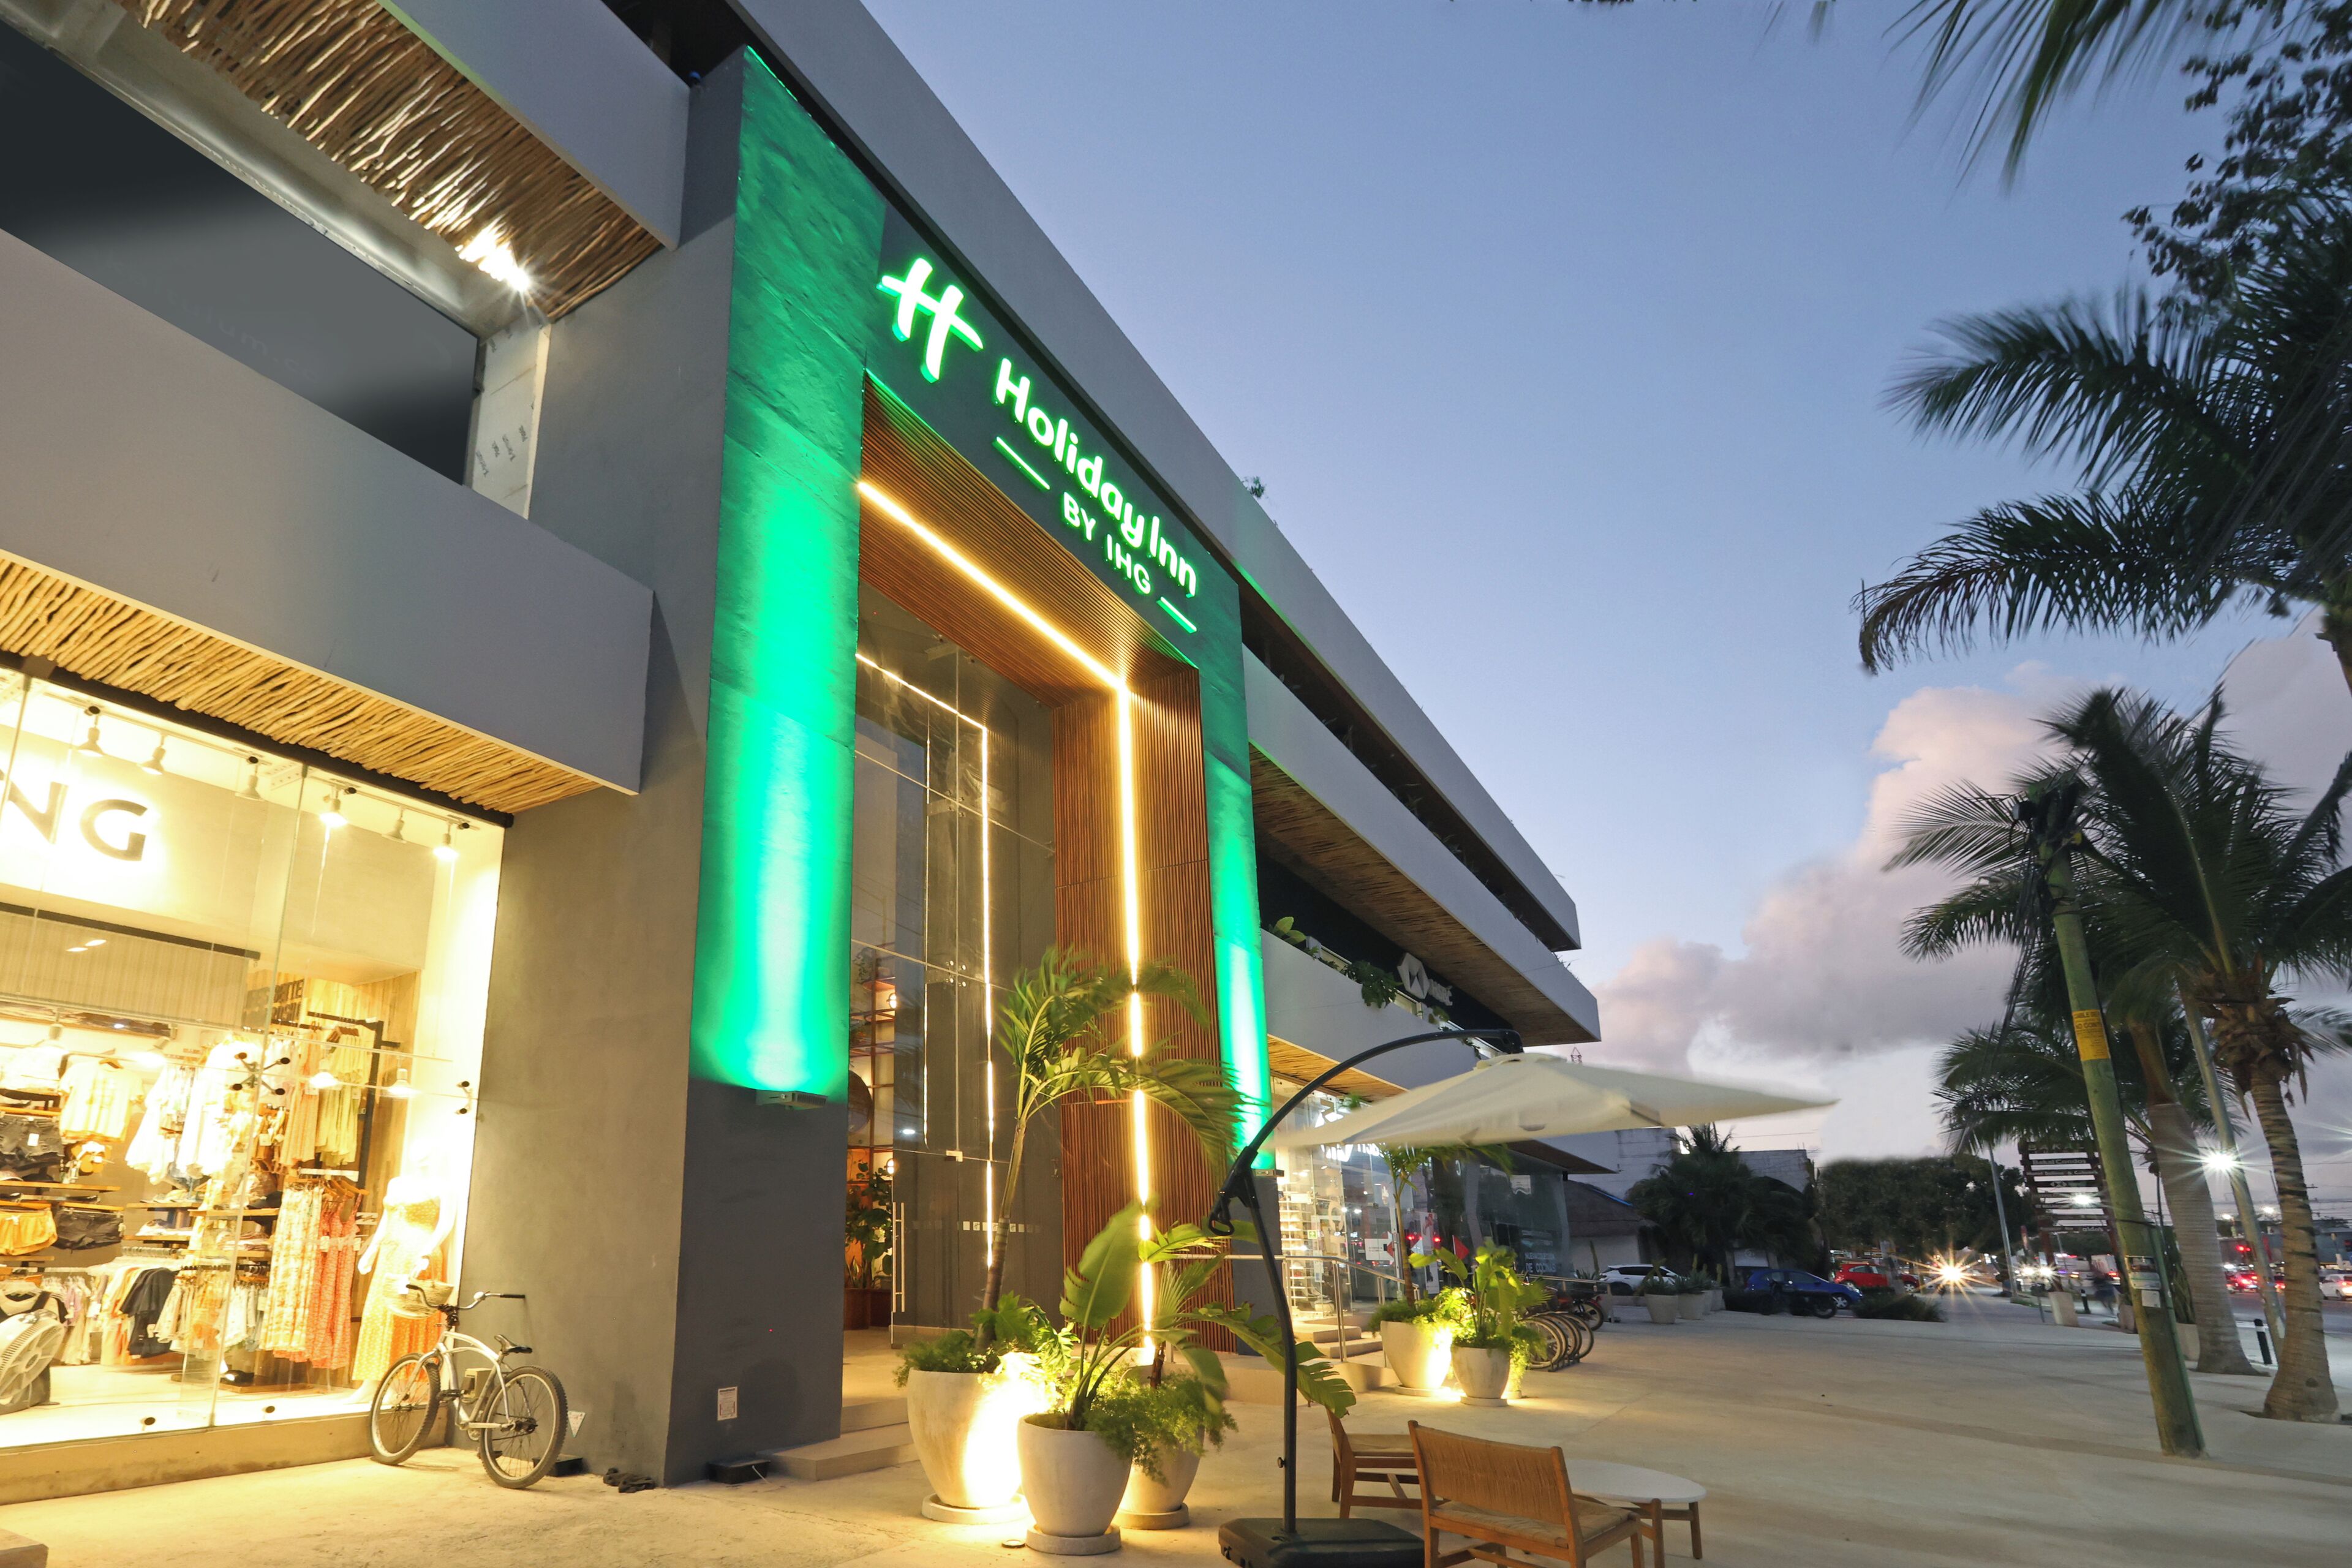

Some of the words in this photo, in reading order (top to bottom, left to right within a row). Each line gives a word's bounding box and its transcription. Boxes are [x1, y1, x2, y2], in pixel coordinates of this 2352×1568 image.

[994, 357, 1145, 548] Holiday
[1149, 515, 1197, 597] Inn
[1063, 491, 1097, 541] BY
[1106, 533, 1152, 595] IHG
